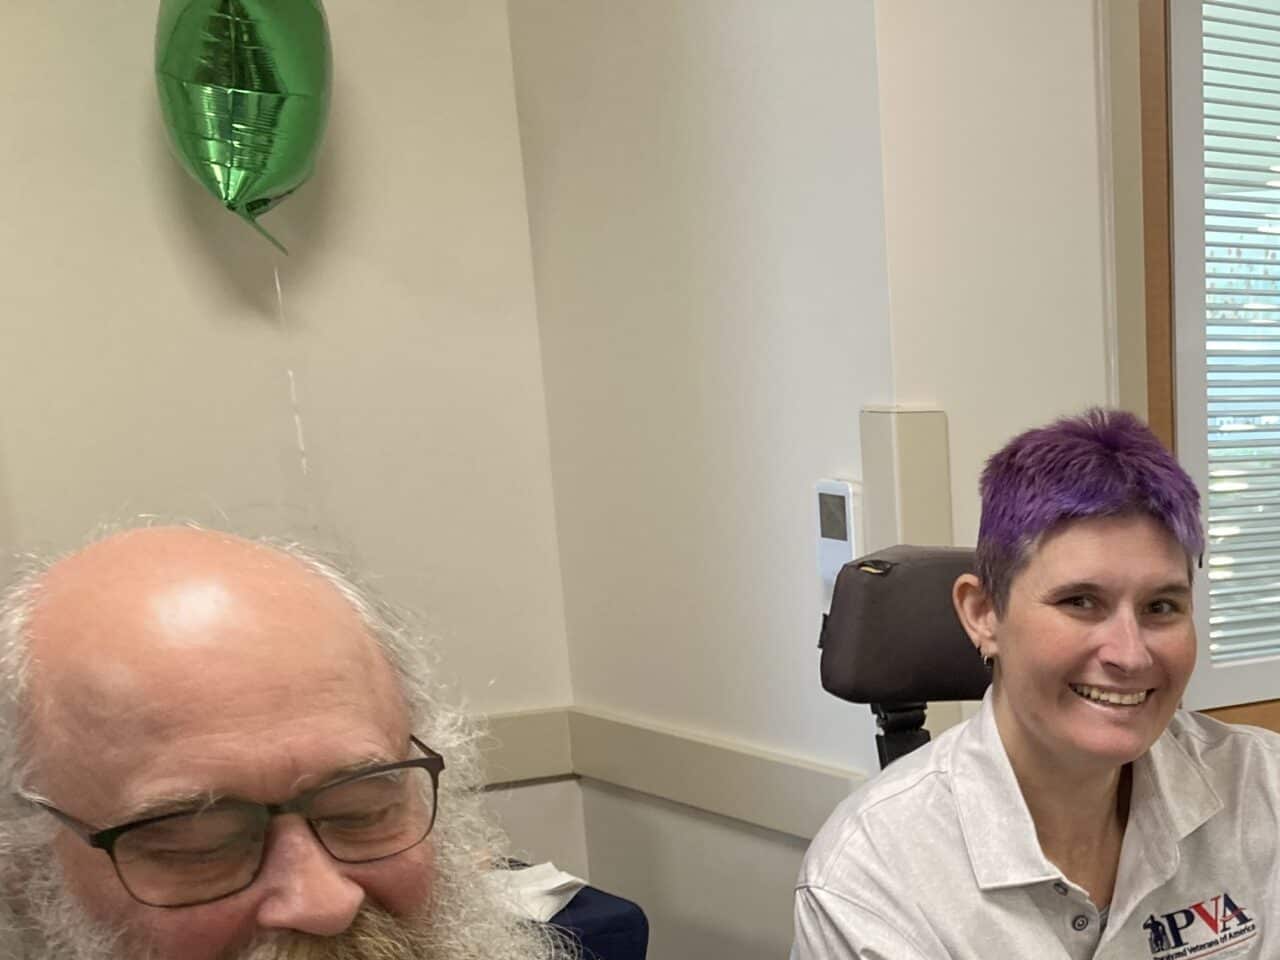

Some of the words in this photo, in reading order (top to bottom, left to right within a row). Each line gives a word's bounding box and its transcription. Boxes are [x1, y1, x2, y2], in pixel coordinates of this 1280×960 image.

[1160, 893, 1253, 949] PVA
[1187, 939, 1219, 954] Veterans
[1228, 923, 1256, 939] America
